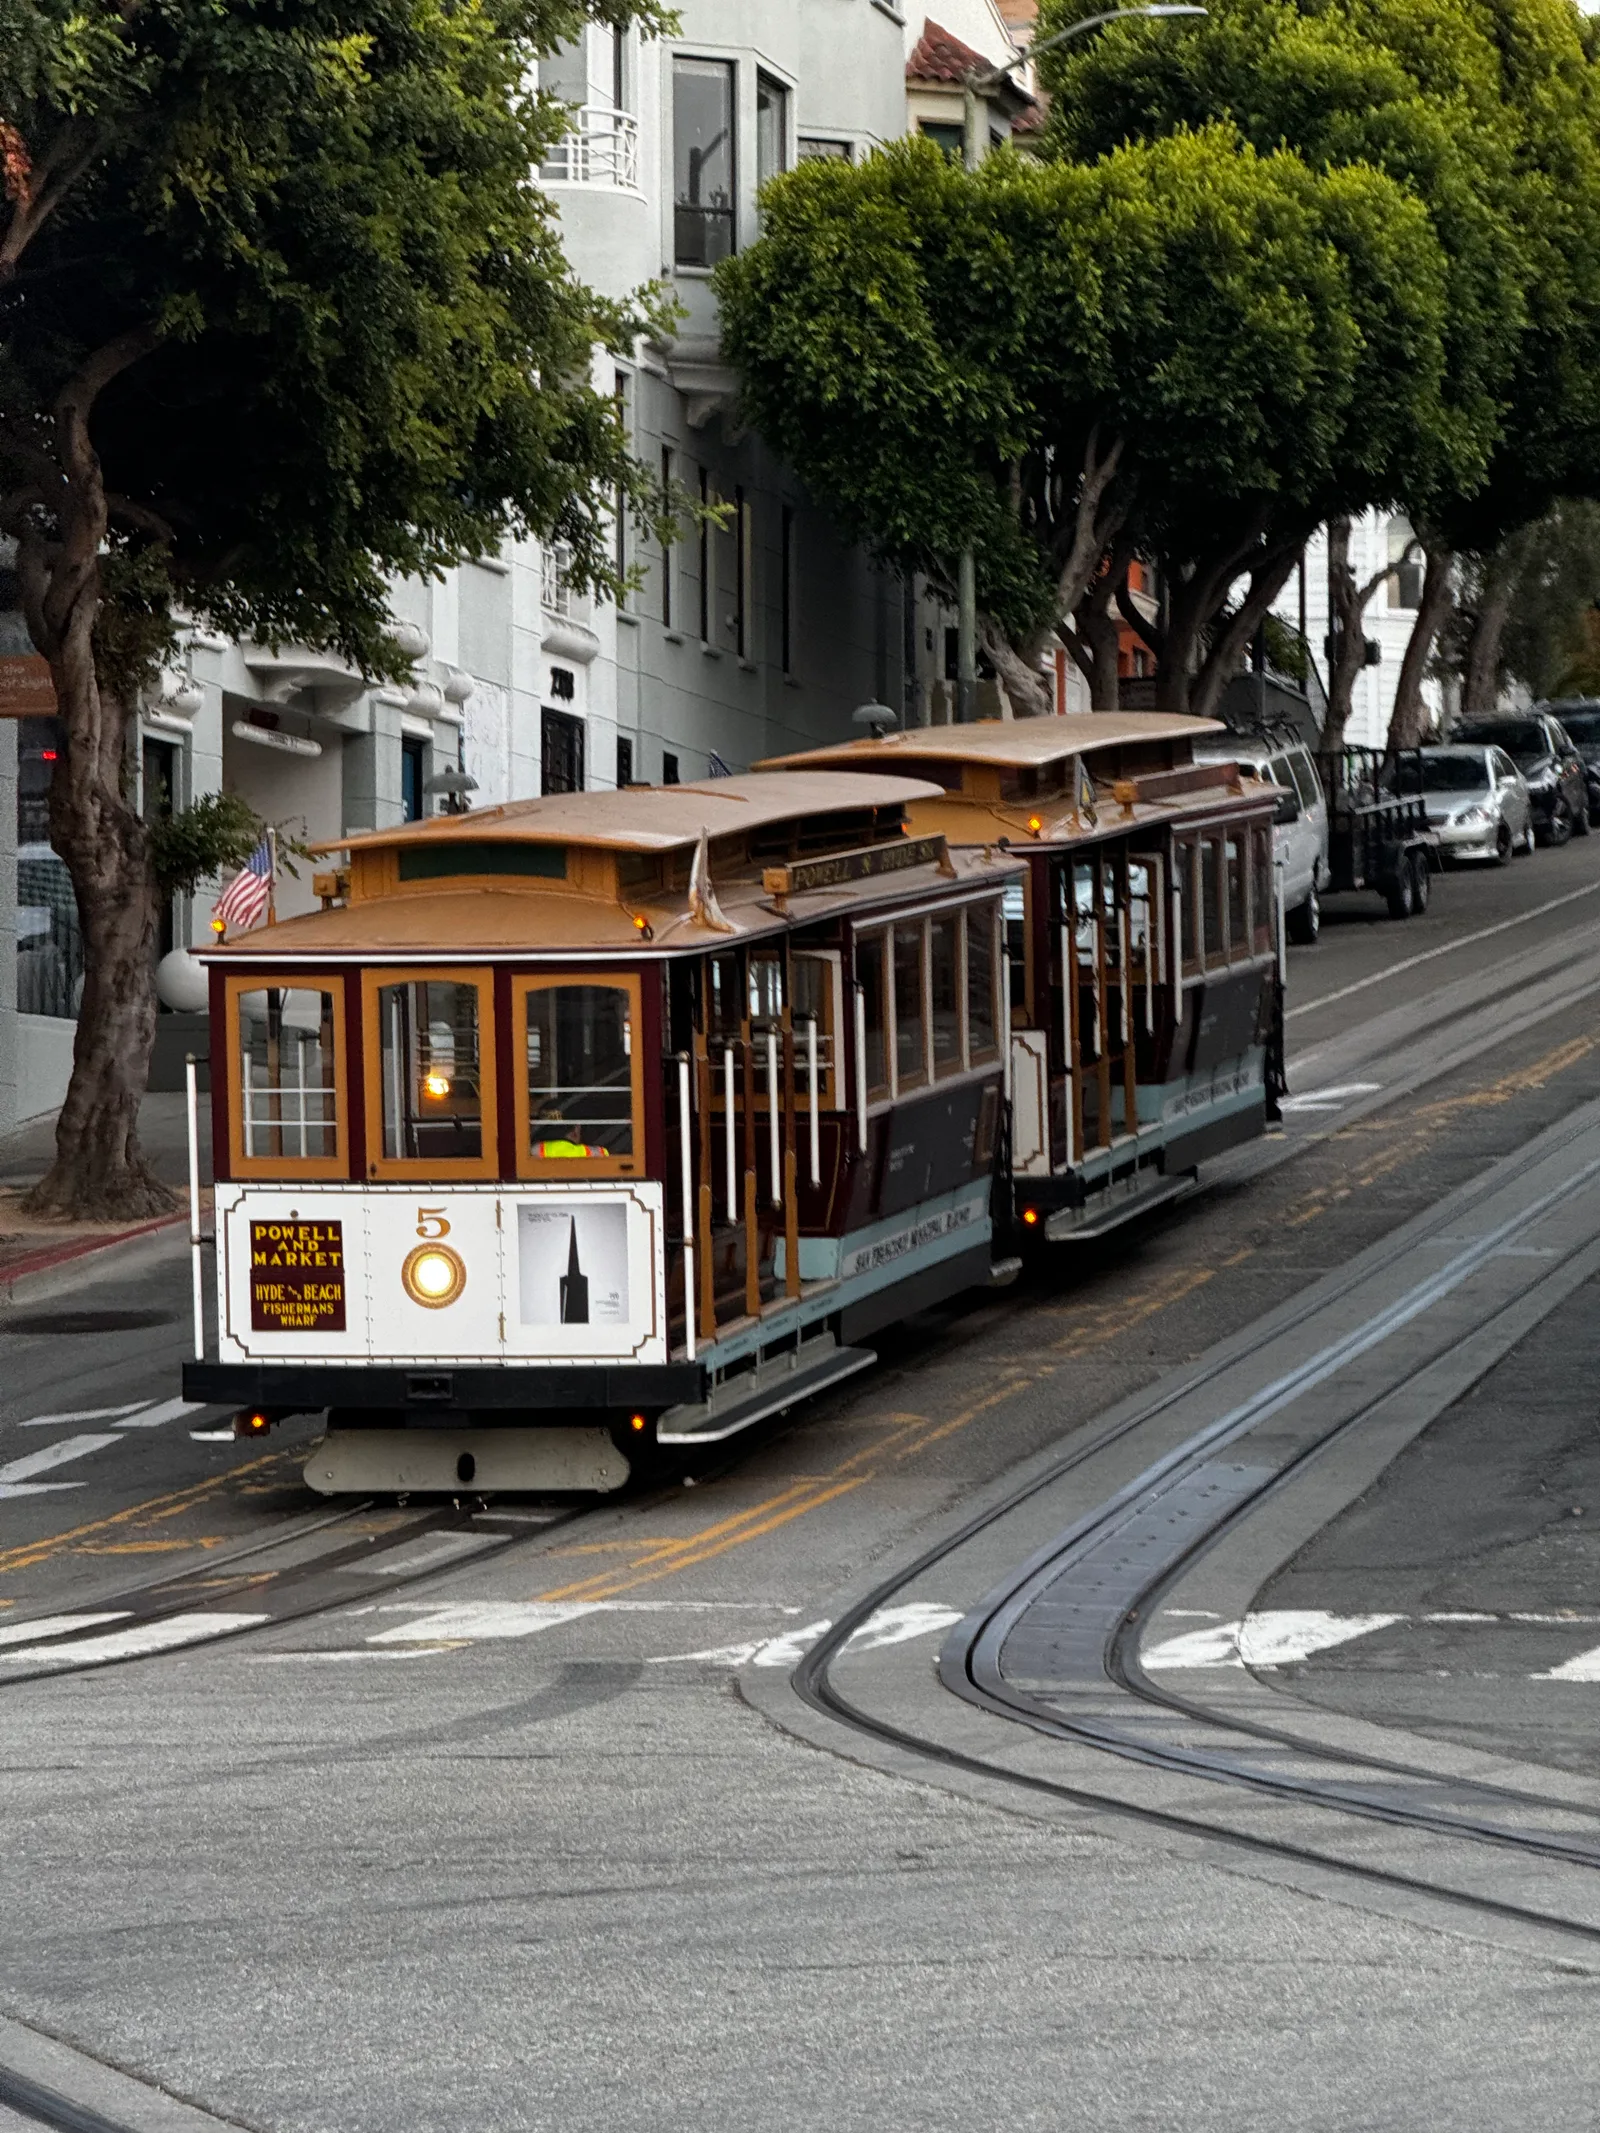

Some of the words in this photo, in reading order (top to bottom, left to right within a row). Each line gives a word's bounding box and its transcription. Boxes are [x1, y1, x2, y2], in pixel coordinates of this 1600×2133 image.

[416, 1206, 451, 1239] 5
[254, 1225, 340, 1241] POWELL
[277, 1240, 319, 1252] AND
[253, 1251, 341, 1267] MARKET
[255, 1283, 286, 1301] HYDE
[303, 1283, 342, 1301] BEACH
[263, 1302, 334, 1315] FISHERMANS
[280, 1314, 318, 1327] WHARF
